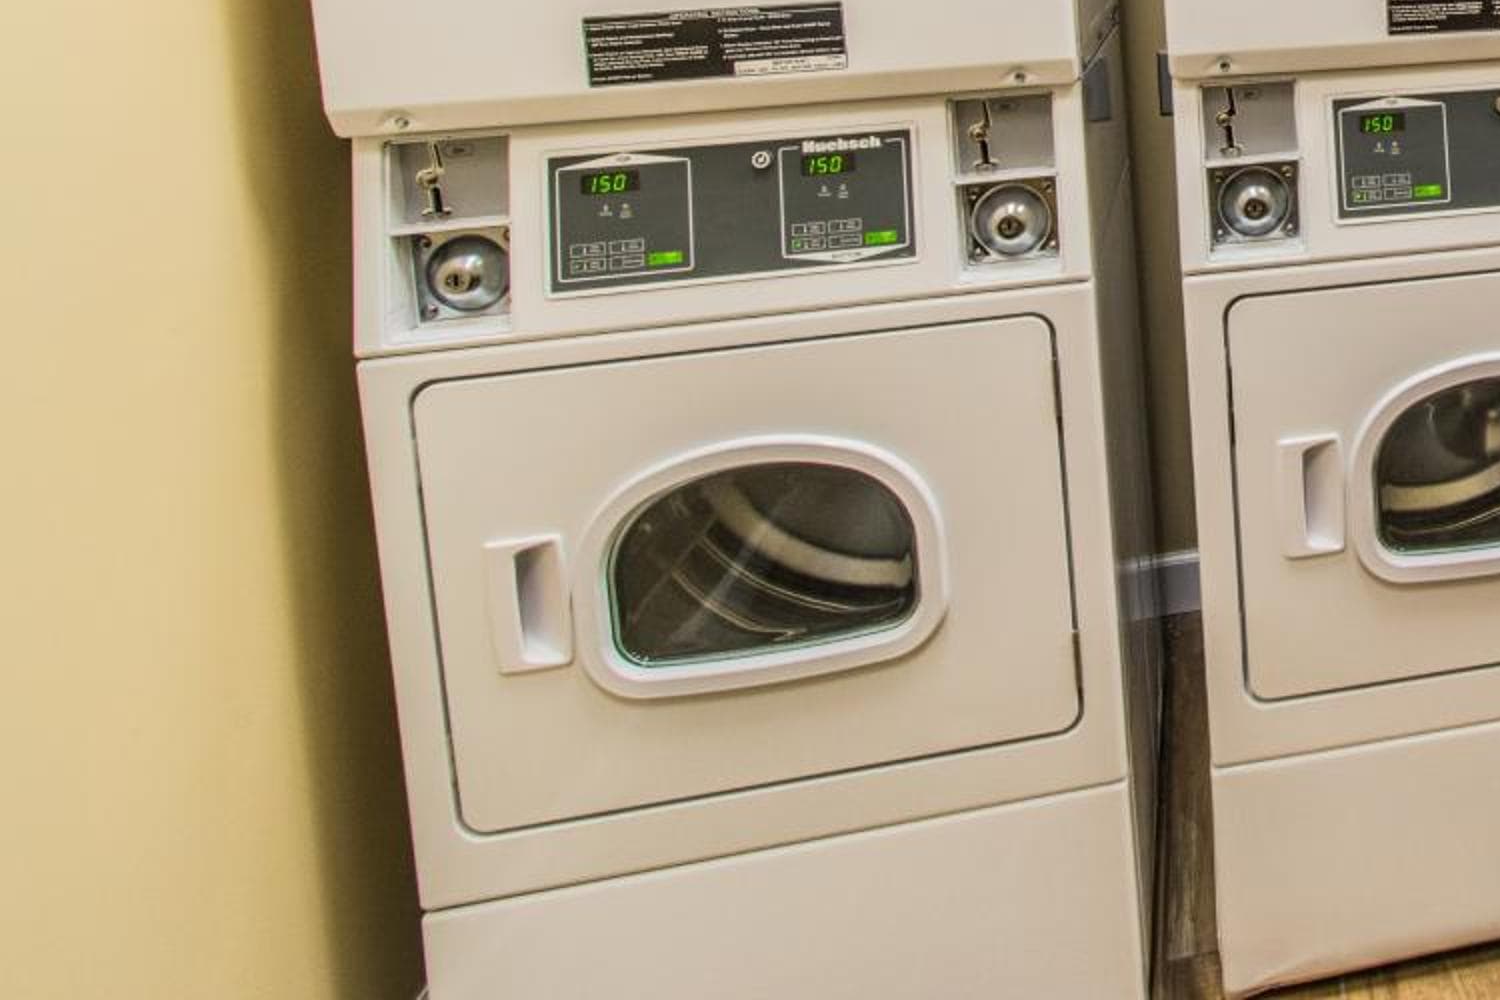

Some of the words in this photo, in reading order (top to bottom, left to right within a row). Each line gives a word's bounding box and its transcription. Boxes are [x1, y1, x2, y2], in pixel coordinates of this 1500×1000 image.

[1364, 115, 1393, 132] 150
[809, 155, 842, 175] 150
[591, 174, 627, 193] 150
